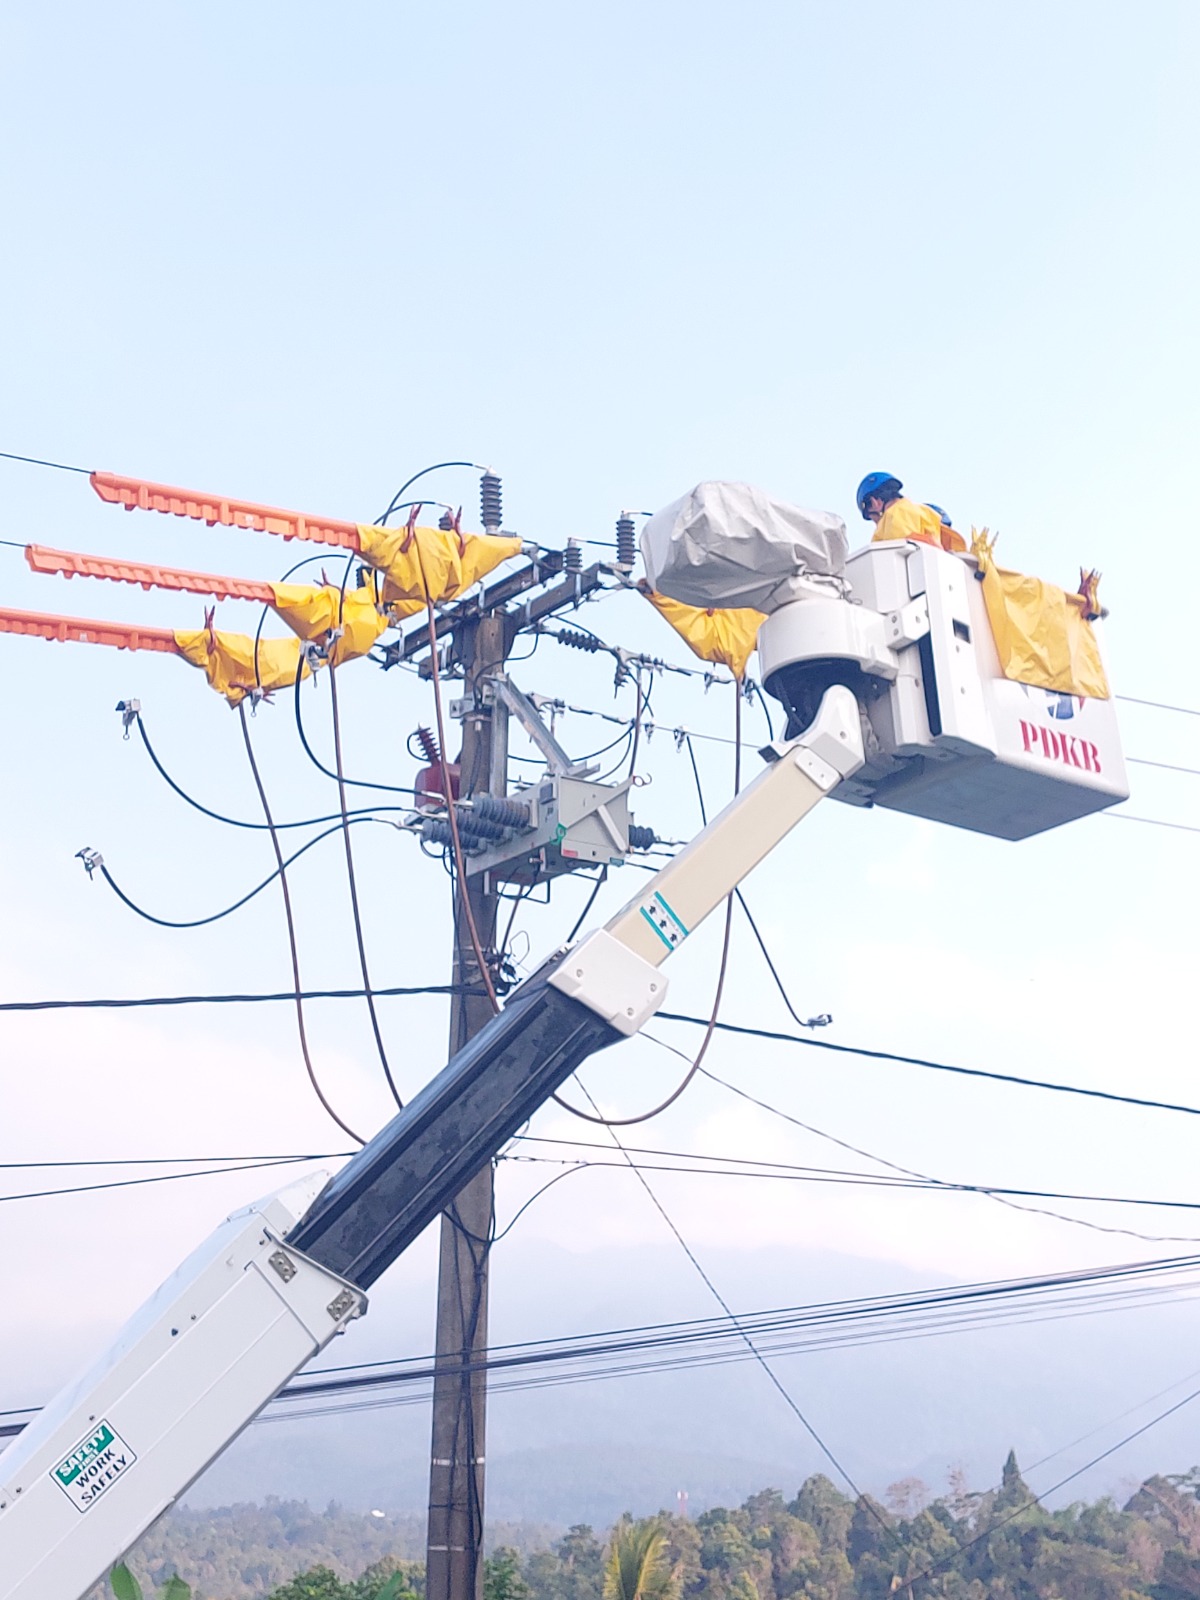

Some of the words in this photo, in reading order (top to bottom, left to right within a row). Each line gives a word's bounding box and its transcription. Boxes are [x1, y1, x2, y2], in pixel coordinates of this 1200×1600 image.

[1019, 719, 1101, 773] PDKB
[59, 1428, 105, 1477] SAFETY
[76, 1448, 115, 1488] WORK
[81, 1454, 127, 1504] SAFELY
